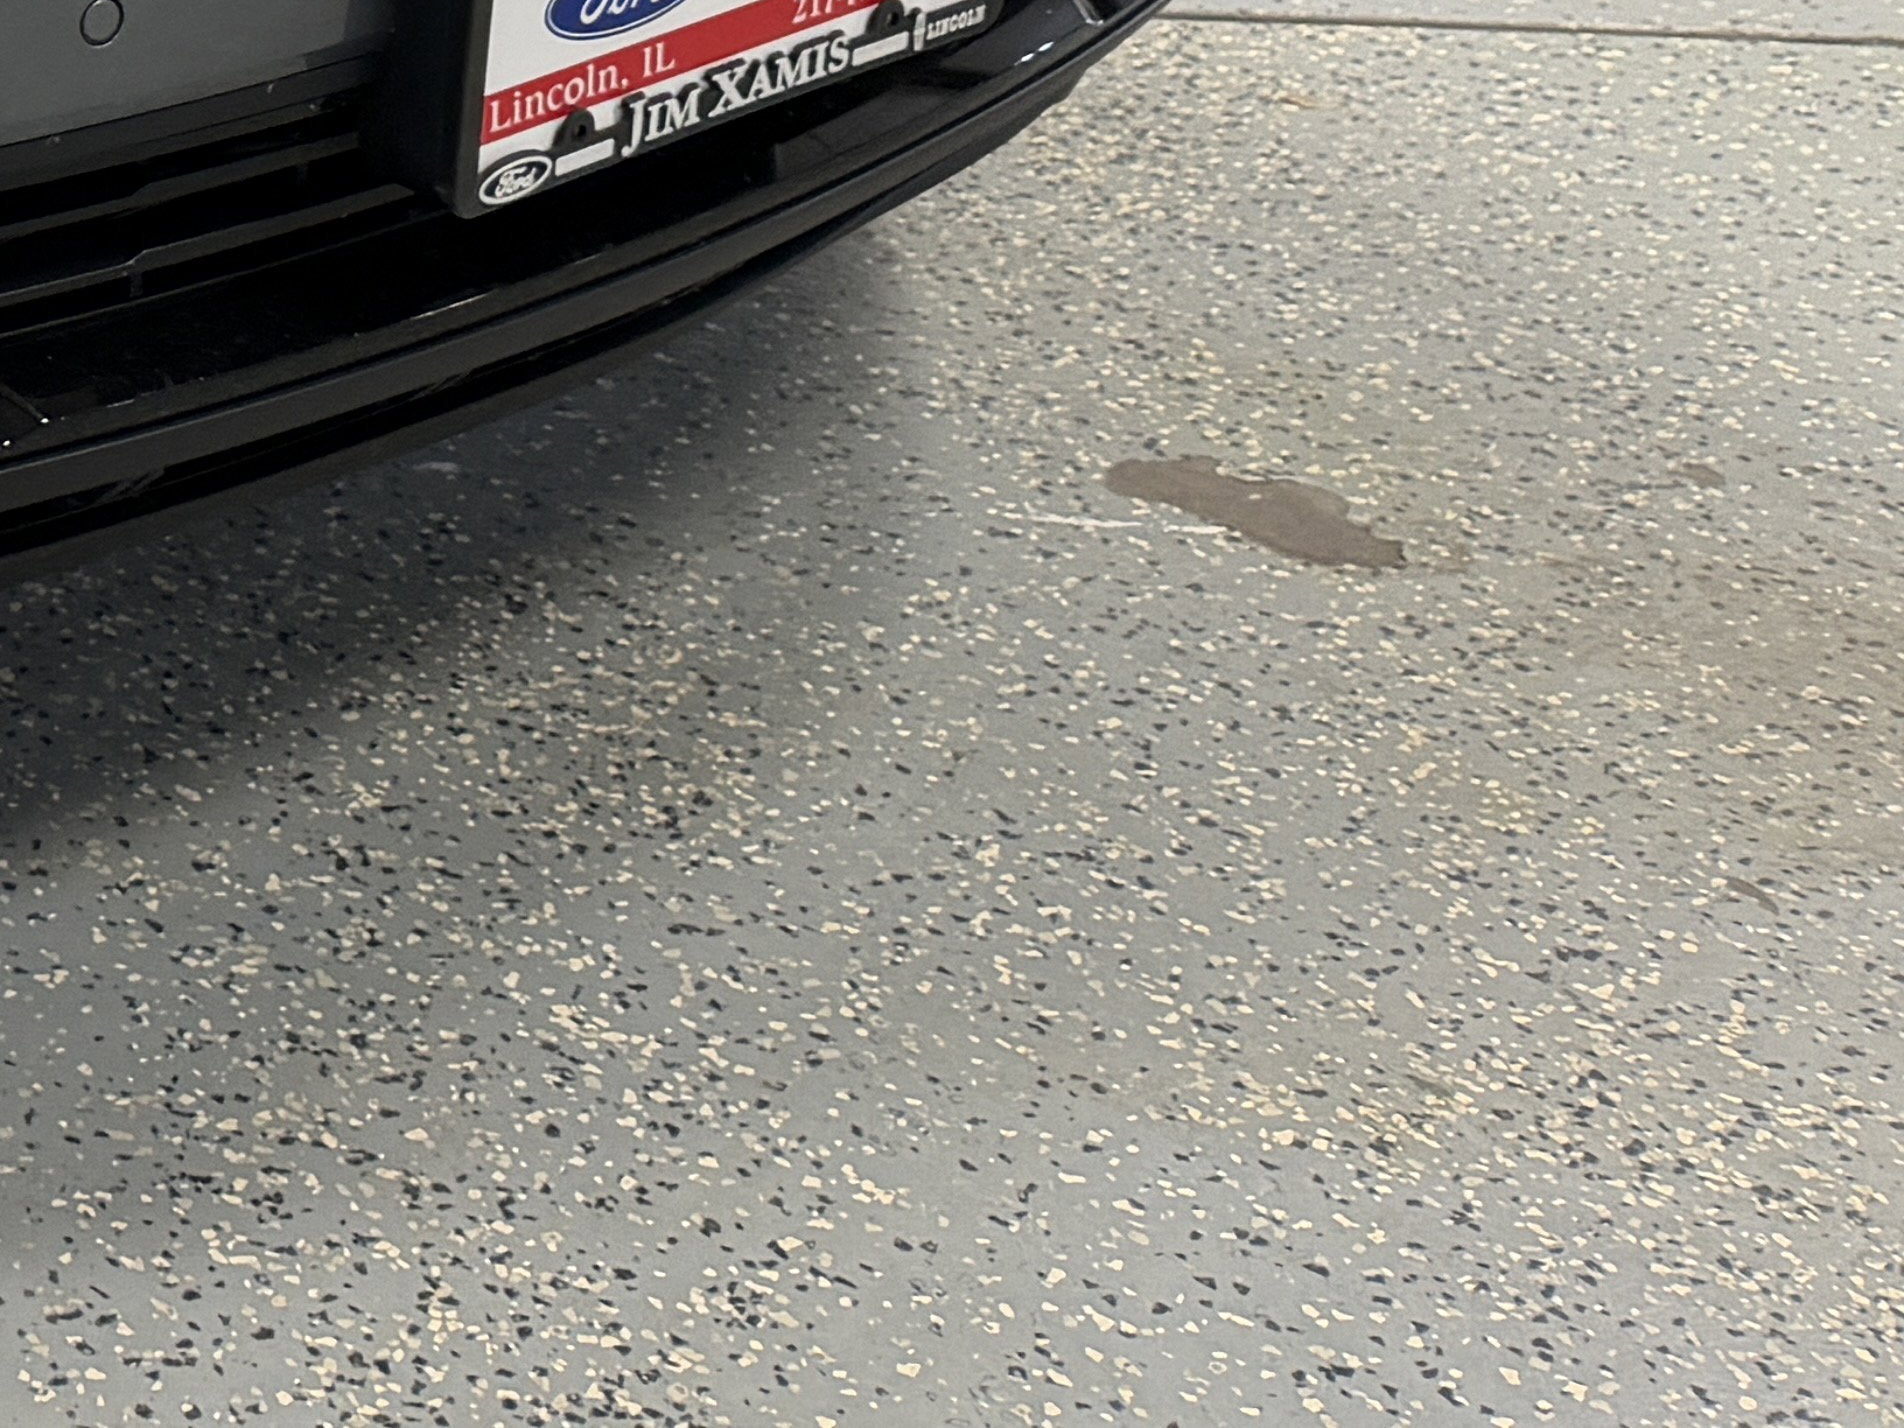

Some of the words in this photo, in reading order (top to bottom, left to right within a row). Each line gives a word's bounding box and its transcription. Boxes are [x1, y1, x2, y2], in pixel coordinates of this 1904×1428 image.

[489, 64, 629, 133] Lincoln,
[642, 42, 675, 77] IL
[621, 87, 701, 157] JIM
[708, 36, 849, 117] XAMIS
